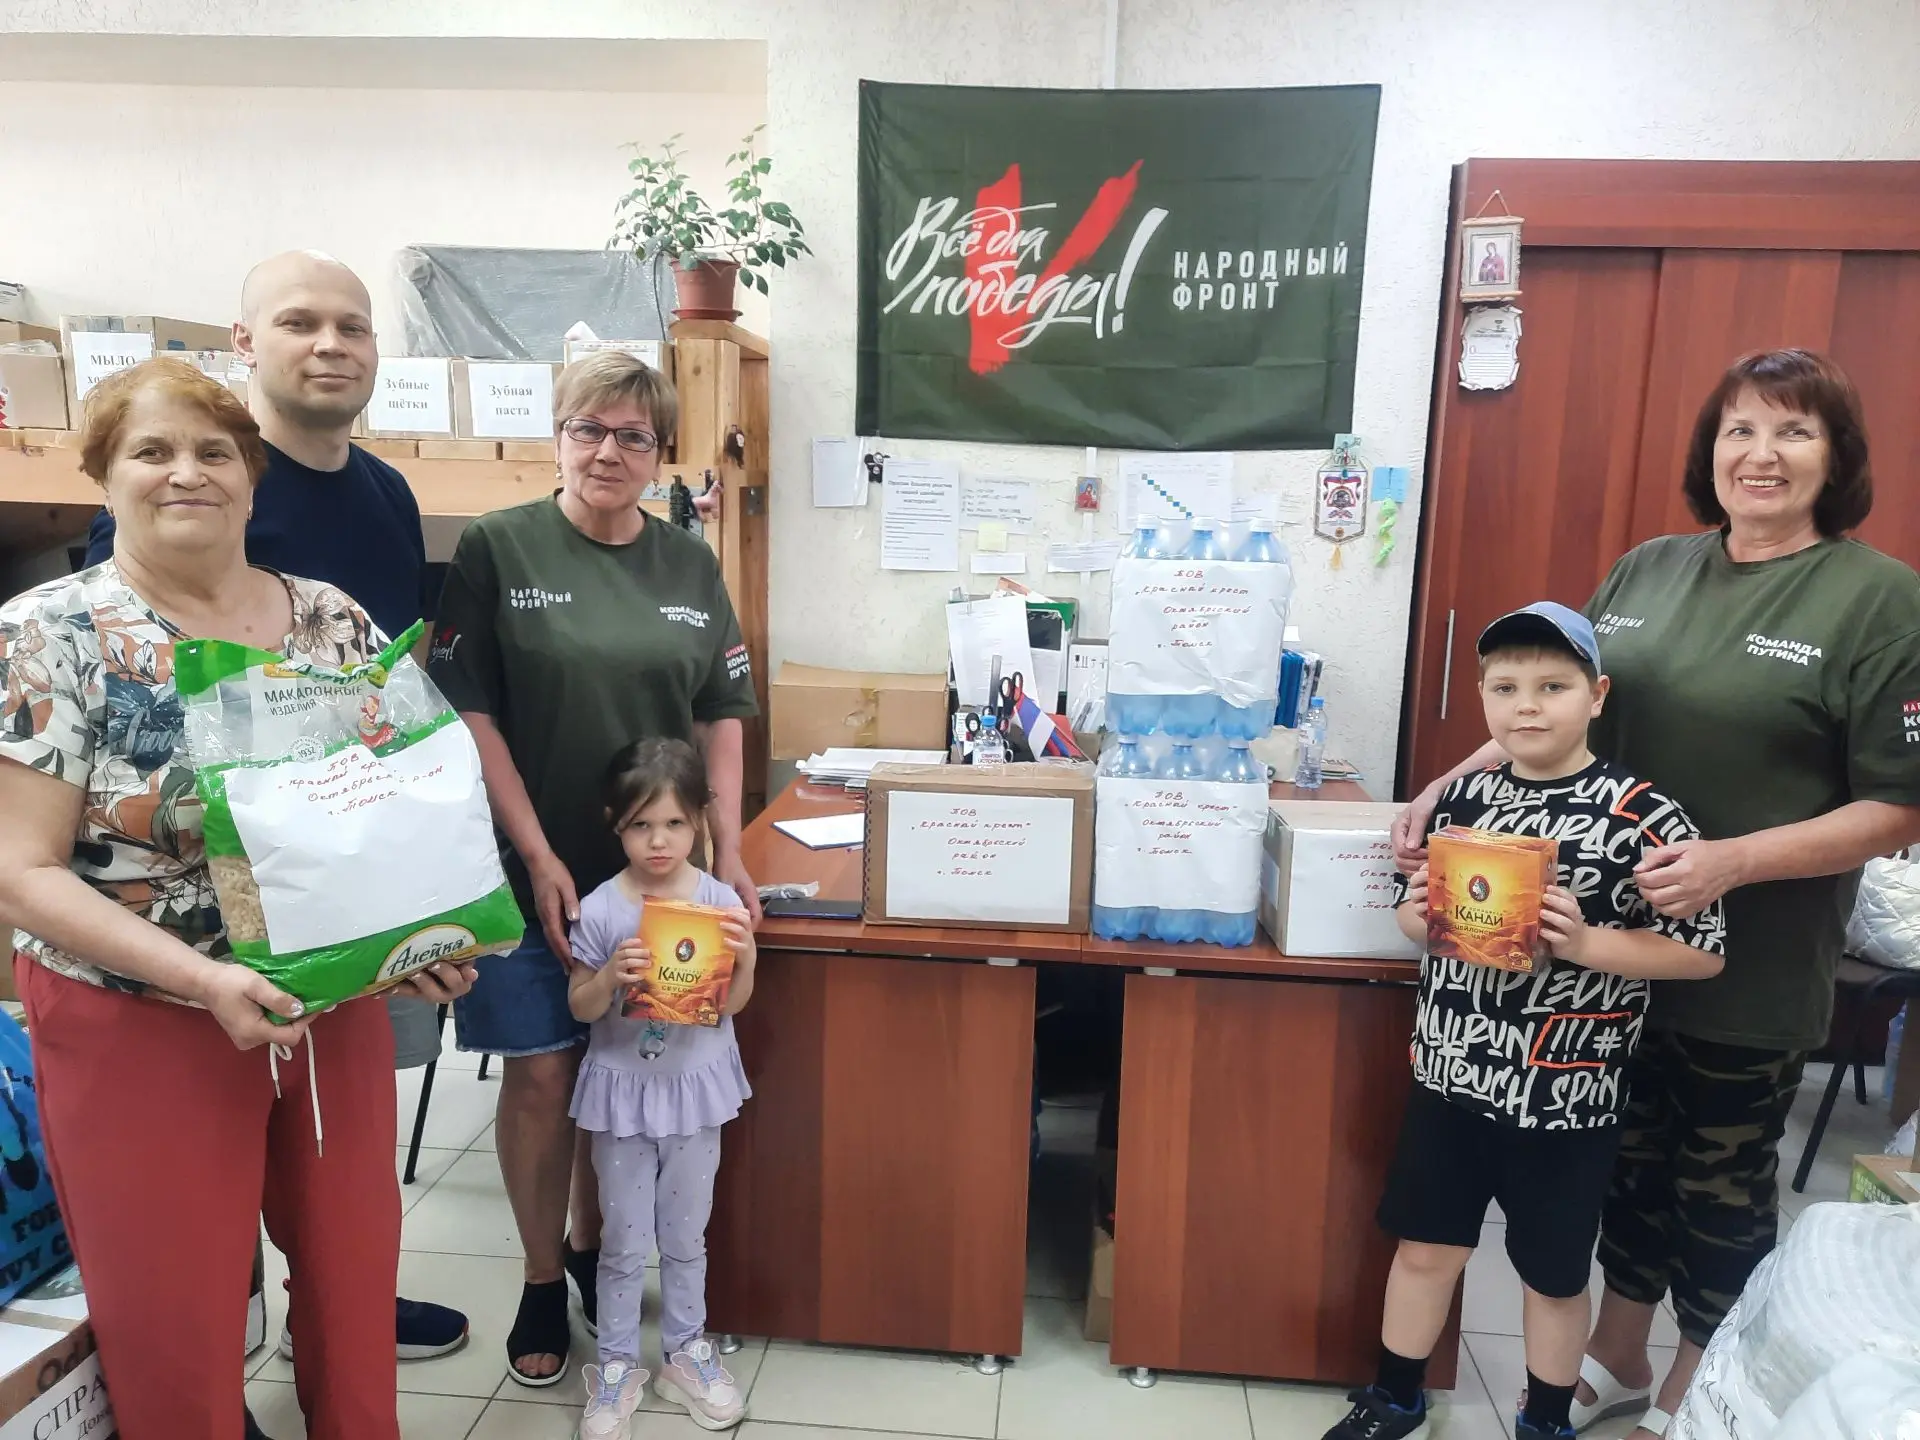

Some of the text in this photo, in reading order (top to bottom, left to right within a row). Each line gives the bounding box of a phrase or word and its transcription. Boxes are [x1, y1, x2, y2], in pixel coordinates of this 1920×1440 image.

[1173, 241, 1348, 280] НАРОДНЫЙ
[1172, 281, 1280, 311] ФРОНТ
[90, 353, 136, 367] МЫЛО
[384, 378, 430, 392] Зубные
[488, 384, 533, 399] Зубная
[495, 406, 530, 416] паста
[510, 588, 572, 602] НАРОДНЫЙ
[511, 598, 548, 609] ФРОНТ
[659, 605, 710, 621] КОМАНДА
[1594, 622, 1619, 636] РОНТ
[1746, 633, 1822, 658] КОМАНДА
[1747, 644, 1809, 666] ПУТИНА
[270, 699, 317, 716] ИЗДЕЛИЯ
[298, 746, 316, 758] 1932
[387, 937, 465, 976] Алейка
[658, 966, 702, 984] KANDY
